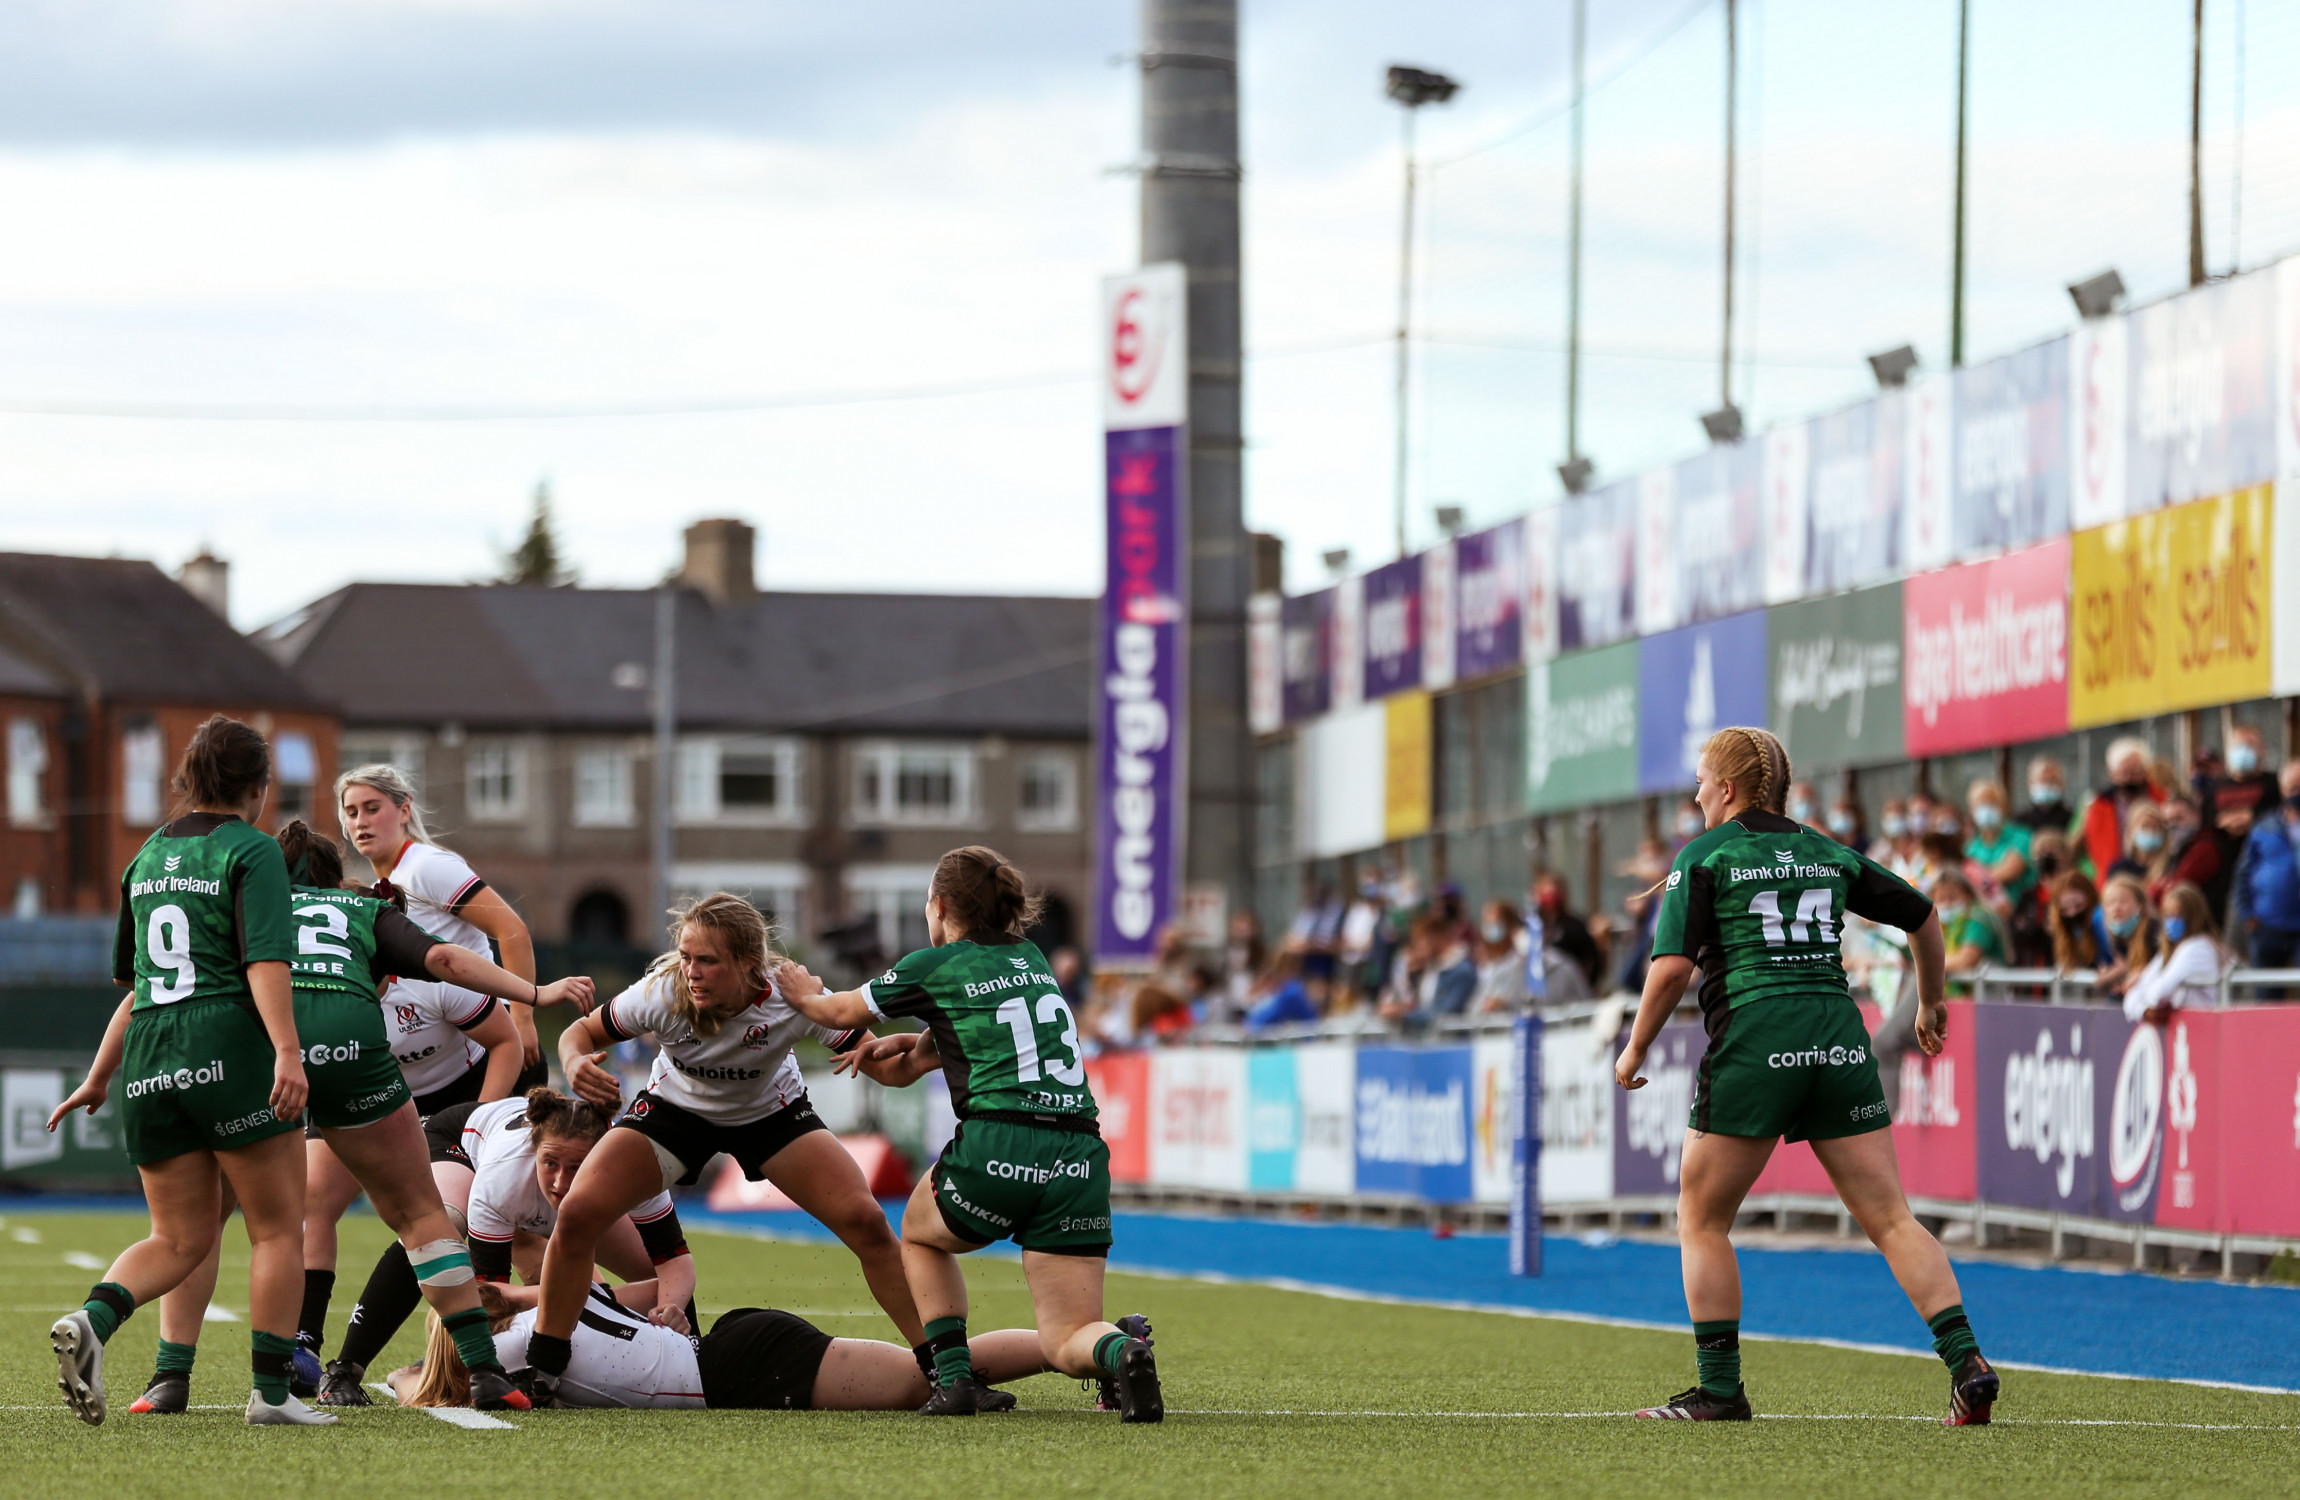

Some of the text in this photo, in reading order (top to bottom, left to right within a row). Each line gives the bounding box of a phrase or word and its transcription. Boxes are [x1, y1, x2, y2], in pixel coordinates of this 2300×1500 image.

[1730, 862, 1842, 882] Bank of Ireland
[131, 876, 220, 898] Bank of Ireland
[1748, 888, 1839, 948] 14
[147, 904, 197, 1006] 9
[290, 961, 344, 976] RIBE
[964, 975, 1013, 998] Bank
[1012, 972, 1029, 987] of
[333, 1040, 360, 1062] oil
[996, 993, 1085, 1087] 13
[1848, 1045, 1867, 1065] oil
[195, 1060, 224, 1085] oil
[672, 1056, 762, 1081] Deloitte
[358, 1080, 403, 1110] GENESYS
[1066, 1159, 1090, 1179] oil
[951, 1192, 1012, 1228] DAIKIN
[1071, 1216, 1111, 1231] GENESY
